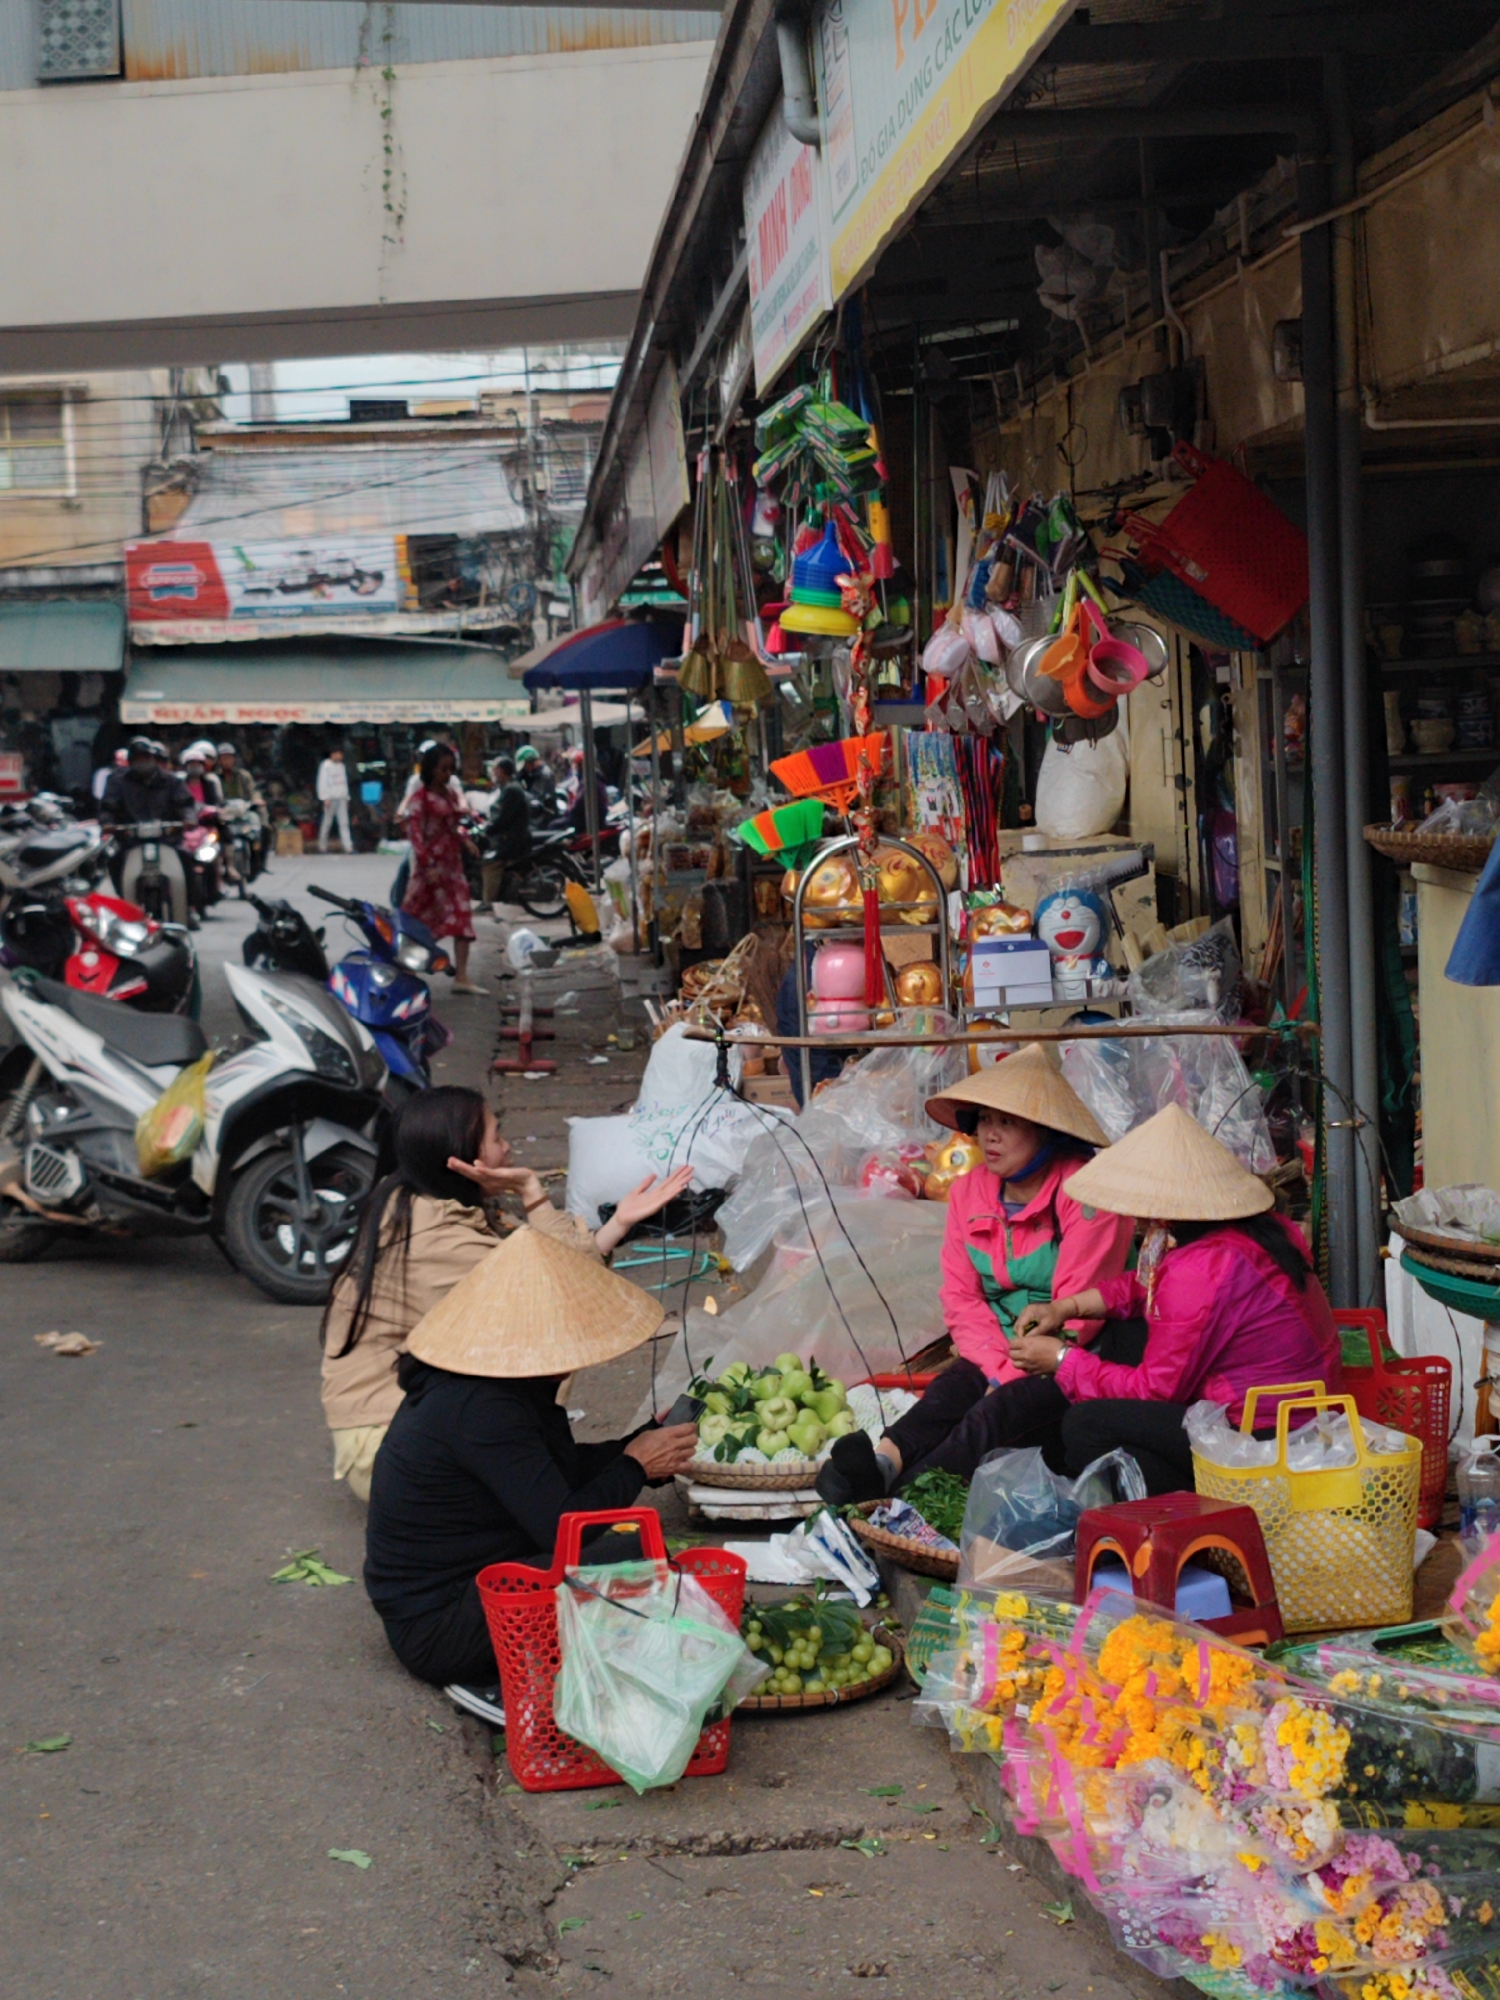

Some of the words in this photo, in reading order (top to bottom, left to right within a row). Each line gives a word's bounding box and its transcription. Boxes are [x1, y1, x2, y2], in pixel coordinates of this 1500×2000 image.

[877, 115, 897, 159] GIA
[898, 56, 933, 131] DỤNG
[935, 8, 962, 71] CÁC
